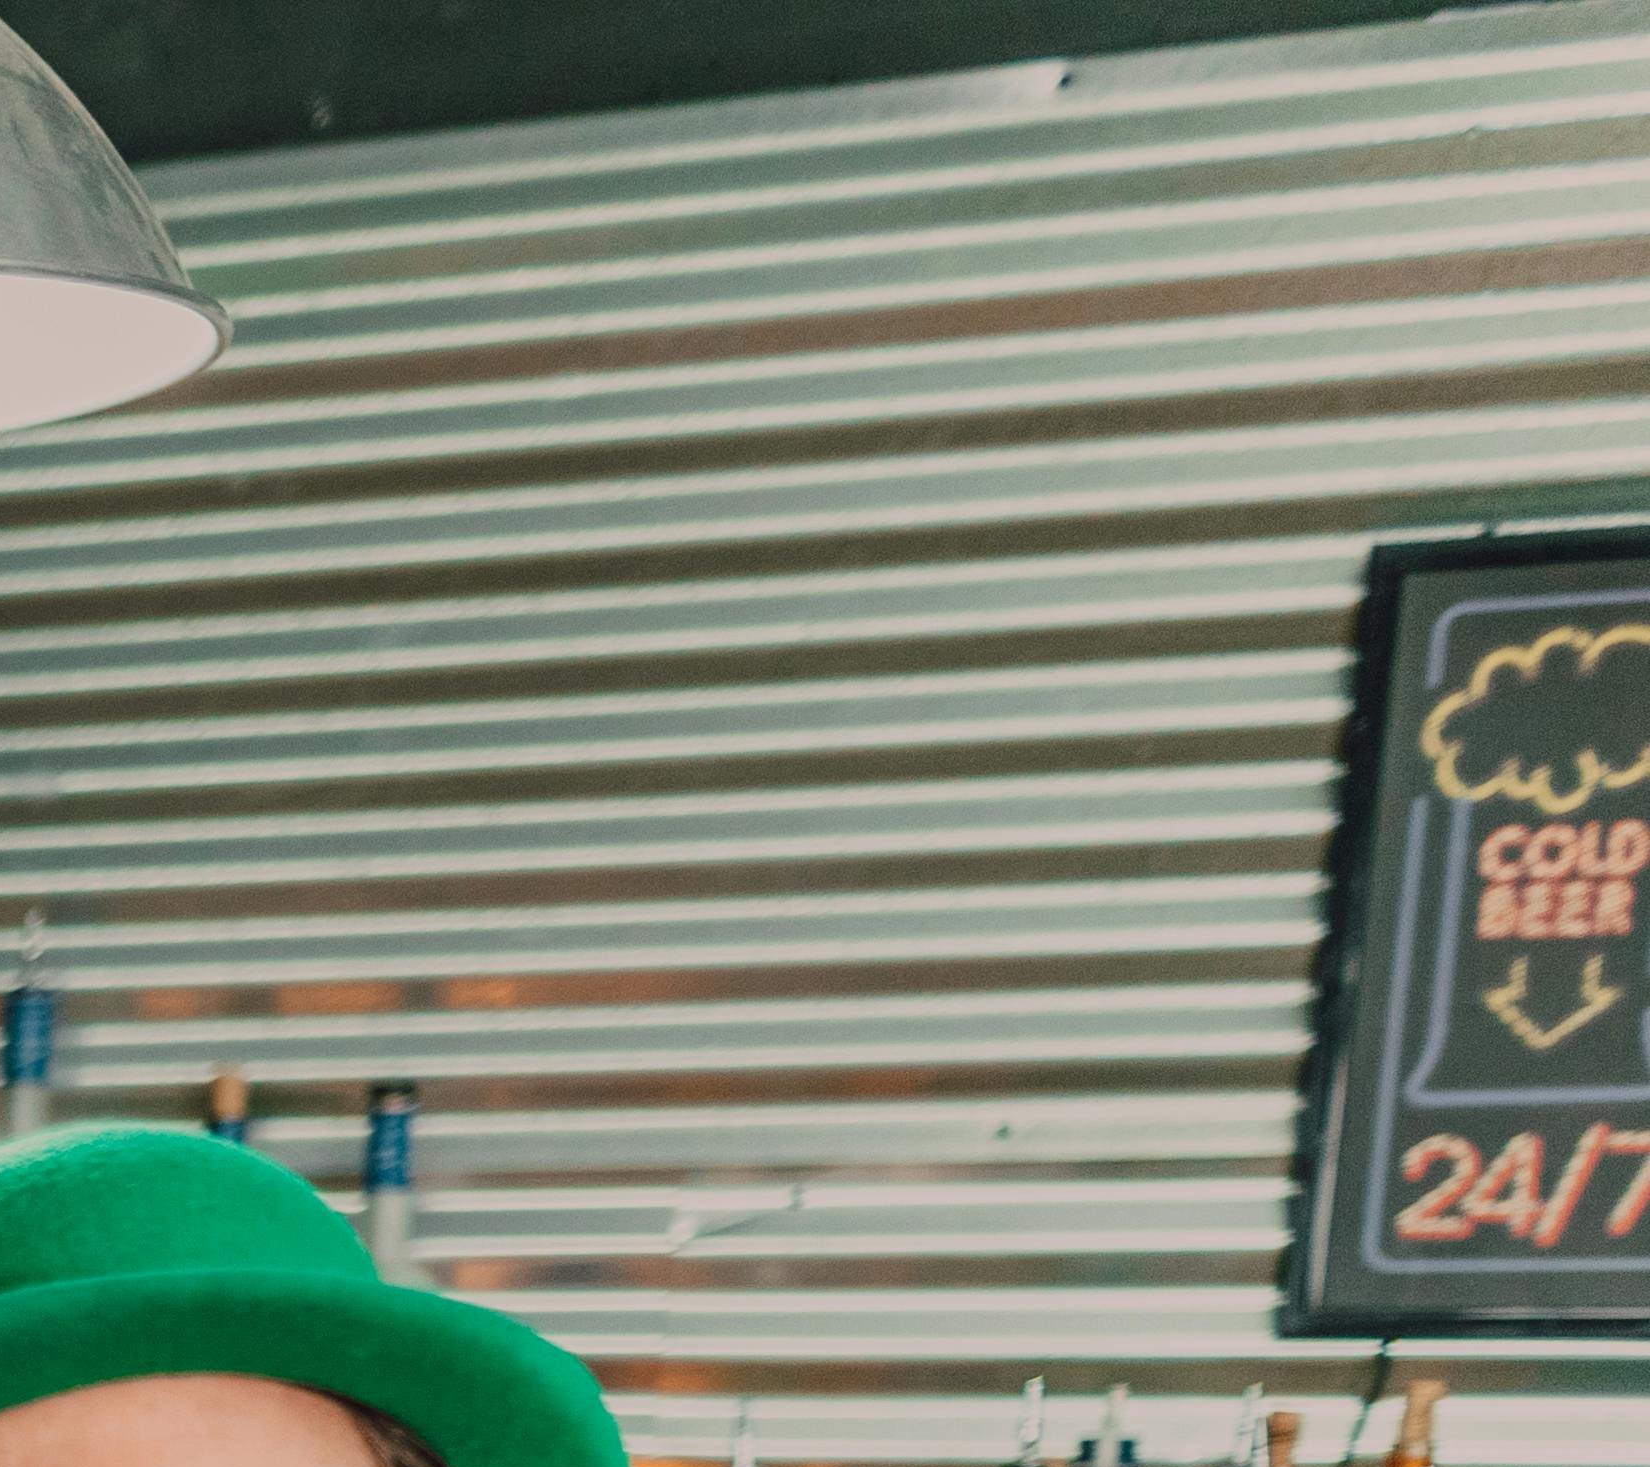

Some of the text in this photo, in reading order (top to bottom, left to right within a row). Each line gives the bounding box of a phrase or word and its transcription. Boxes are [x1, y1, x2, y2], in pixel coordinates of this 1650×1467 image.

[1477, 818, 1650, 882] COLD
[1476, 878, 1637, 940] BEER
[1393, 1122, 1650, 1248] 24/7
